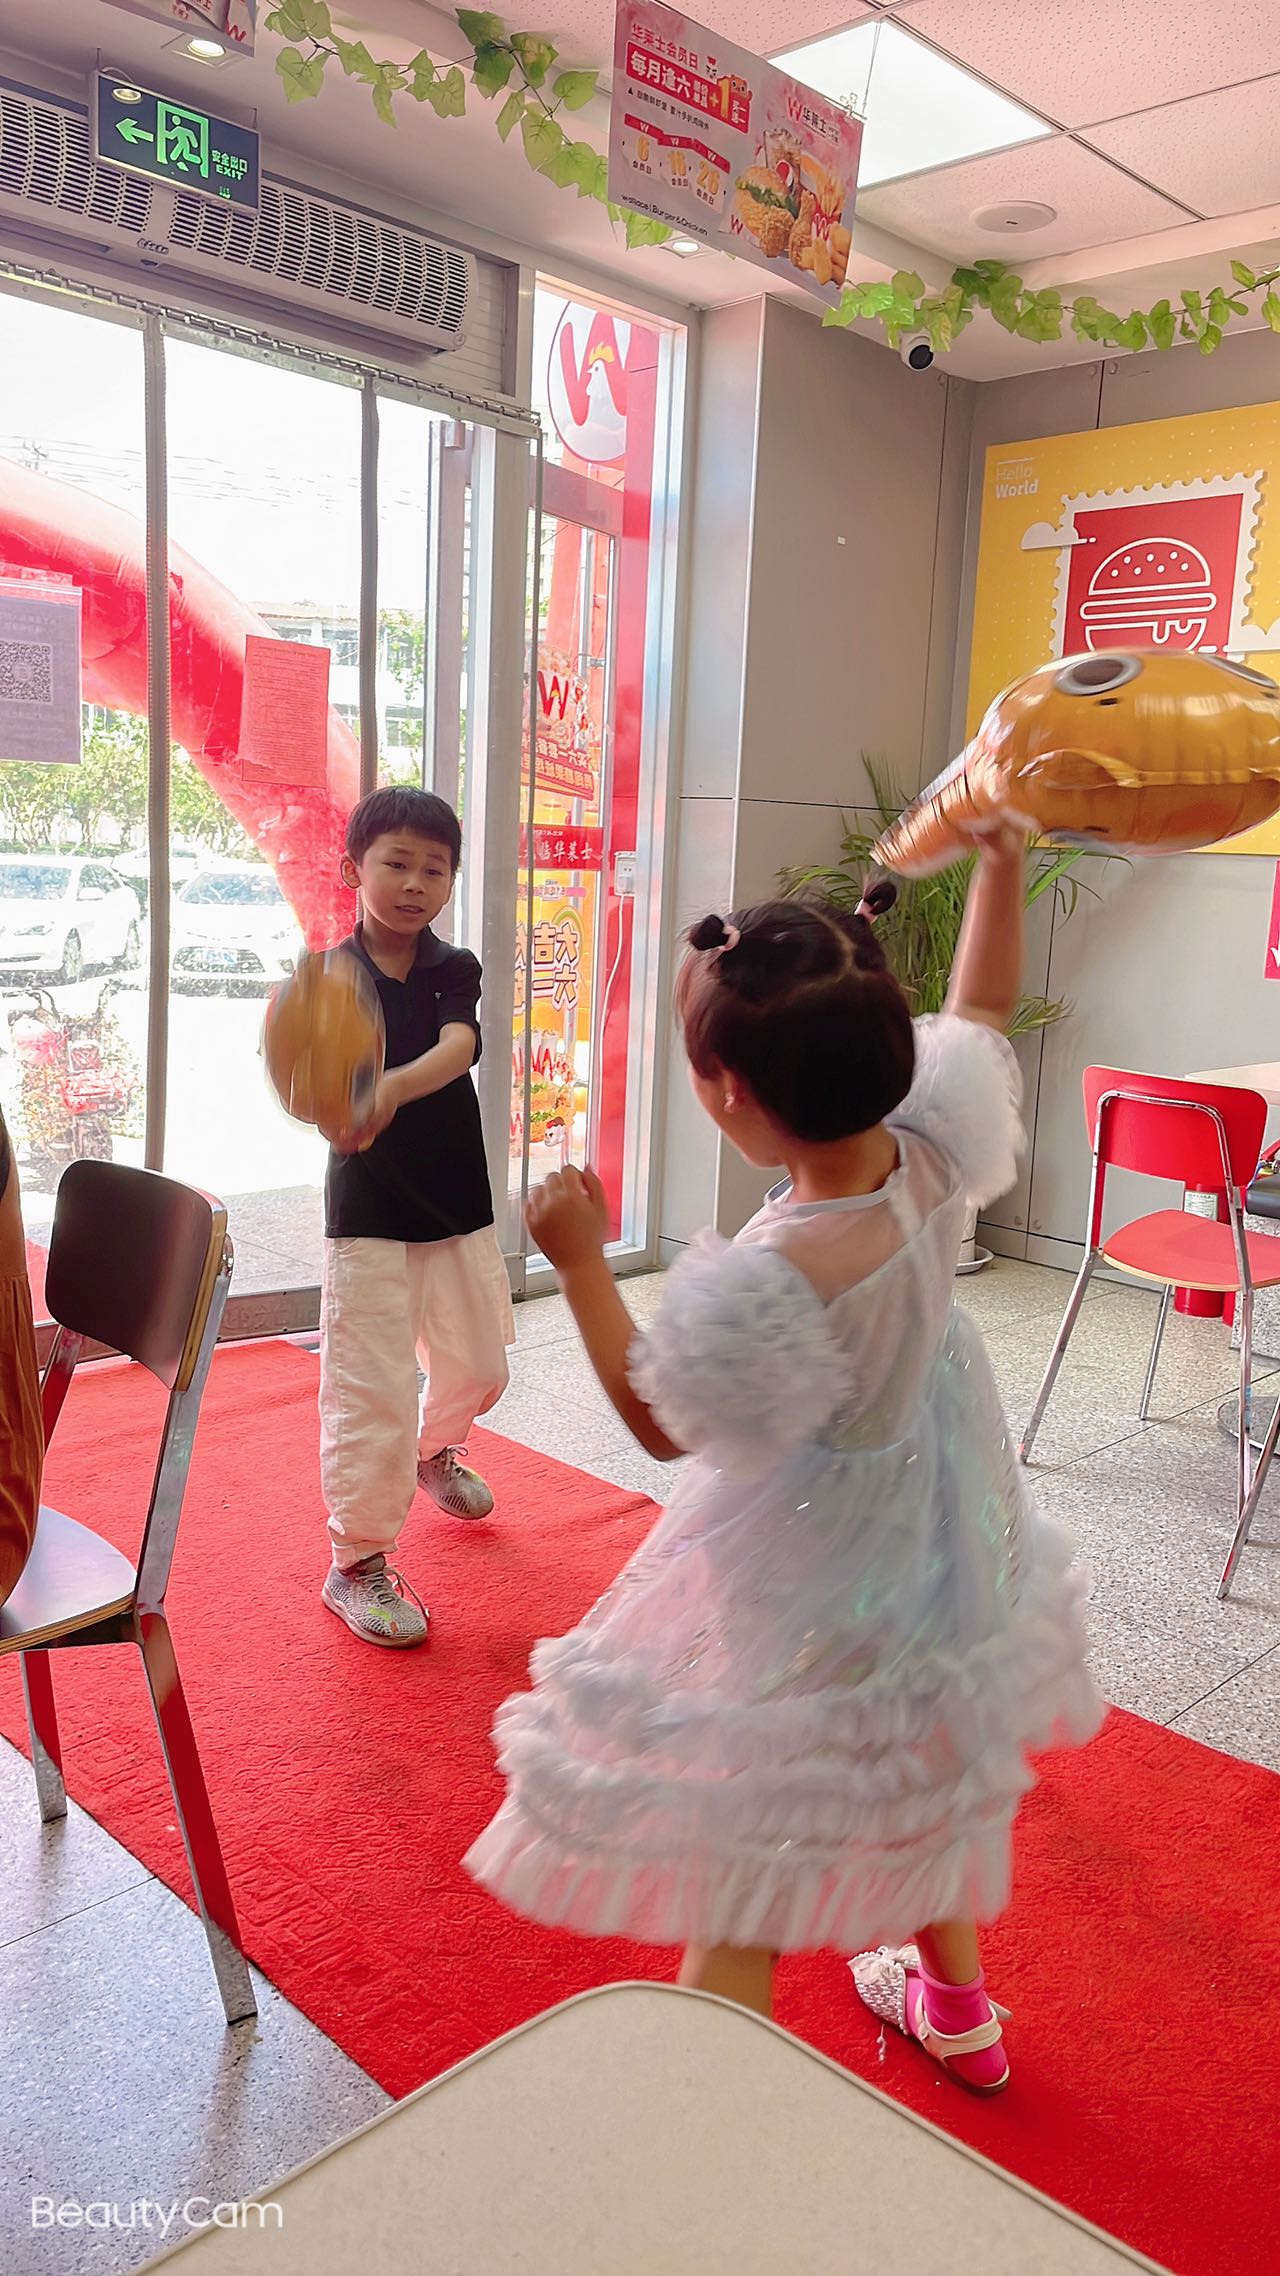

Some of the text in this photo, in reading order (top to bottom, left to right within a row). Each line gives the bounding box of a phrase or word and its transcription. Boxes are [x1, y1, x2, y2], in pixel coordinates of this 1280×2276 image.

[632, 23, 698, 70] 华莱士会员日
[631, 50, 691, 98] 每月逢六
[803, 106, 827, 134] 华莱士
[638, 135, 650, 162] 6
[211, 150, 248, 173] 安全出口
[216, 164, 244, 180] EXIT
[632, 160, 653, 175] 会员日
[667, 150, 686, 177] 16
[697, 160, 720, 196] 26
[696, 188, 715, 206] 会员日
[996, 463, 1033, 480] Hello
[996, 479, 1039, 499] World
